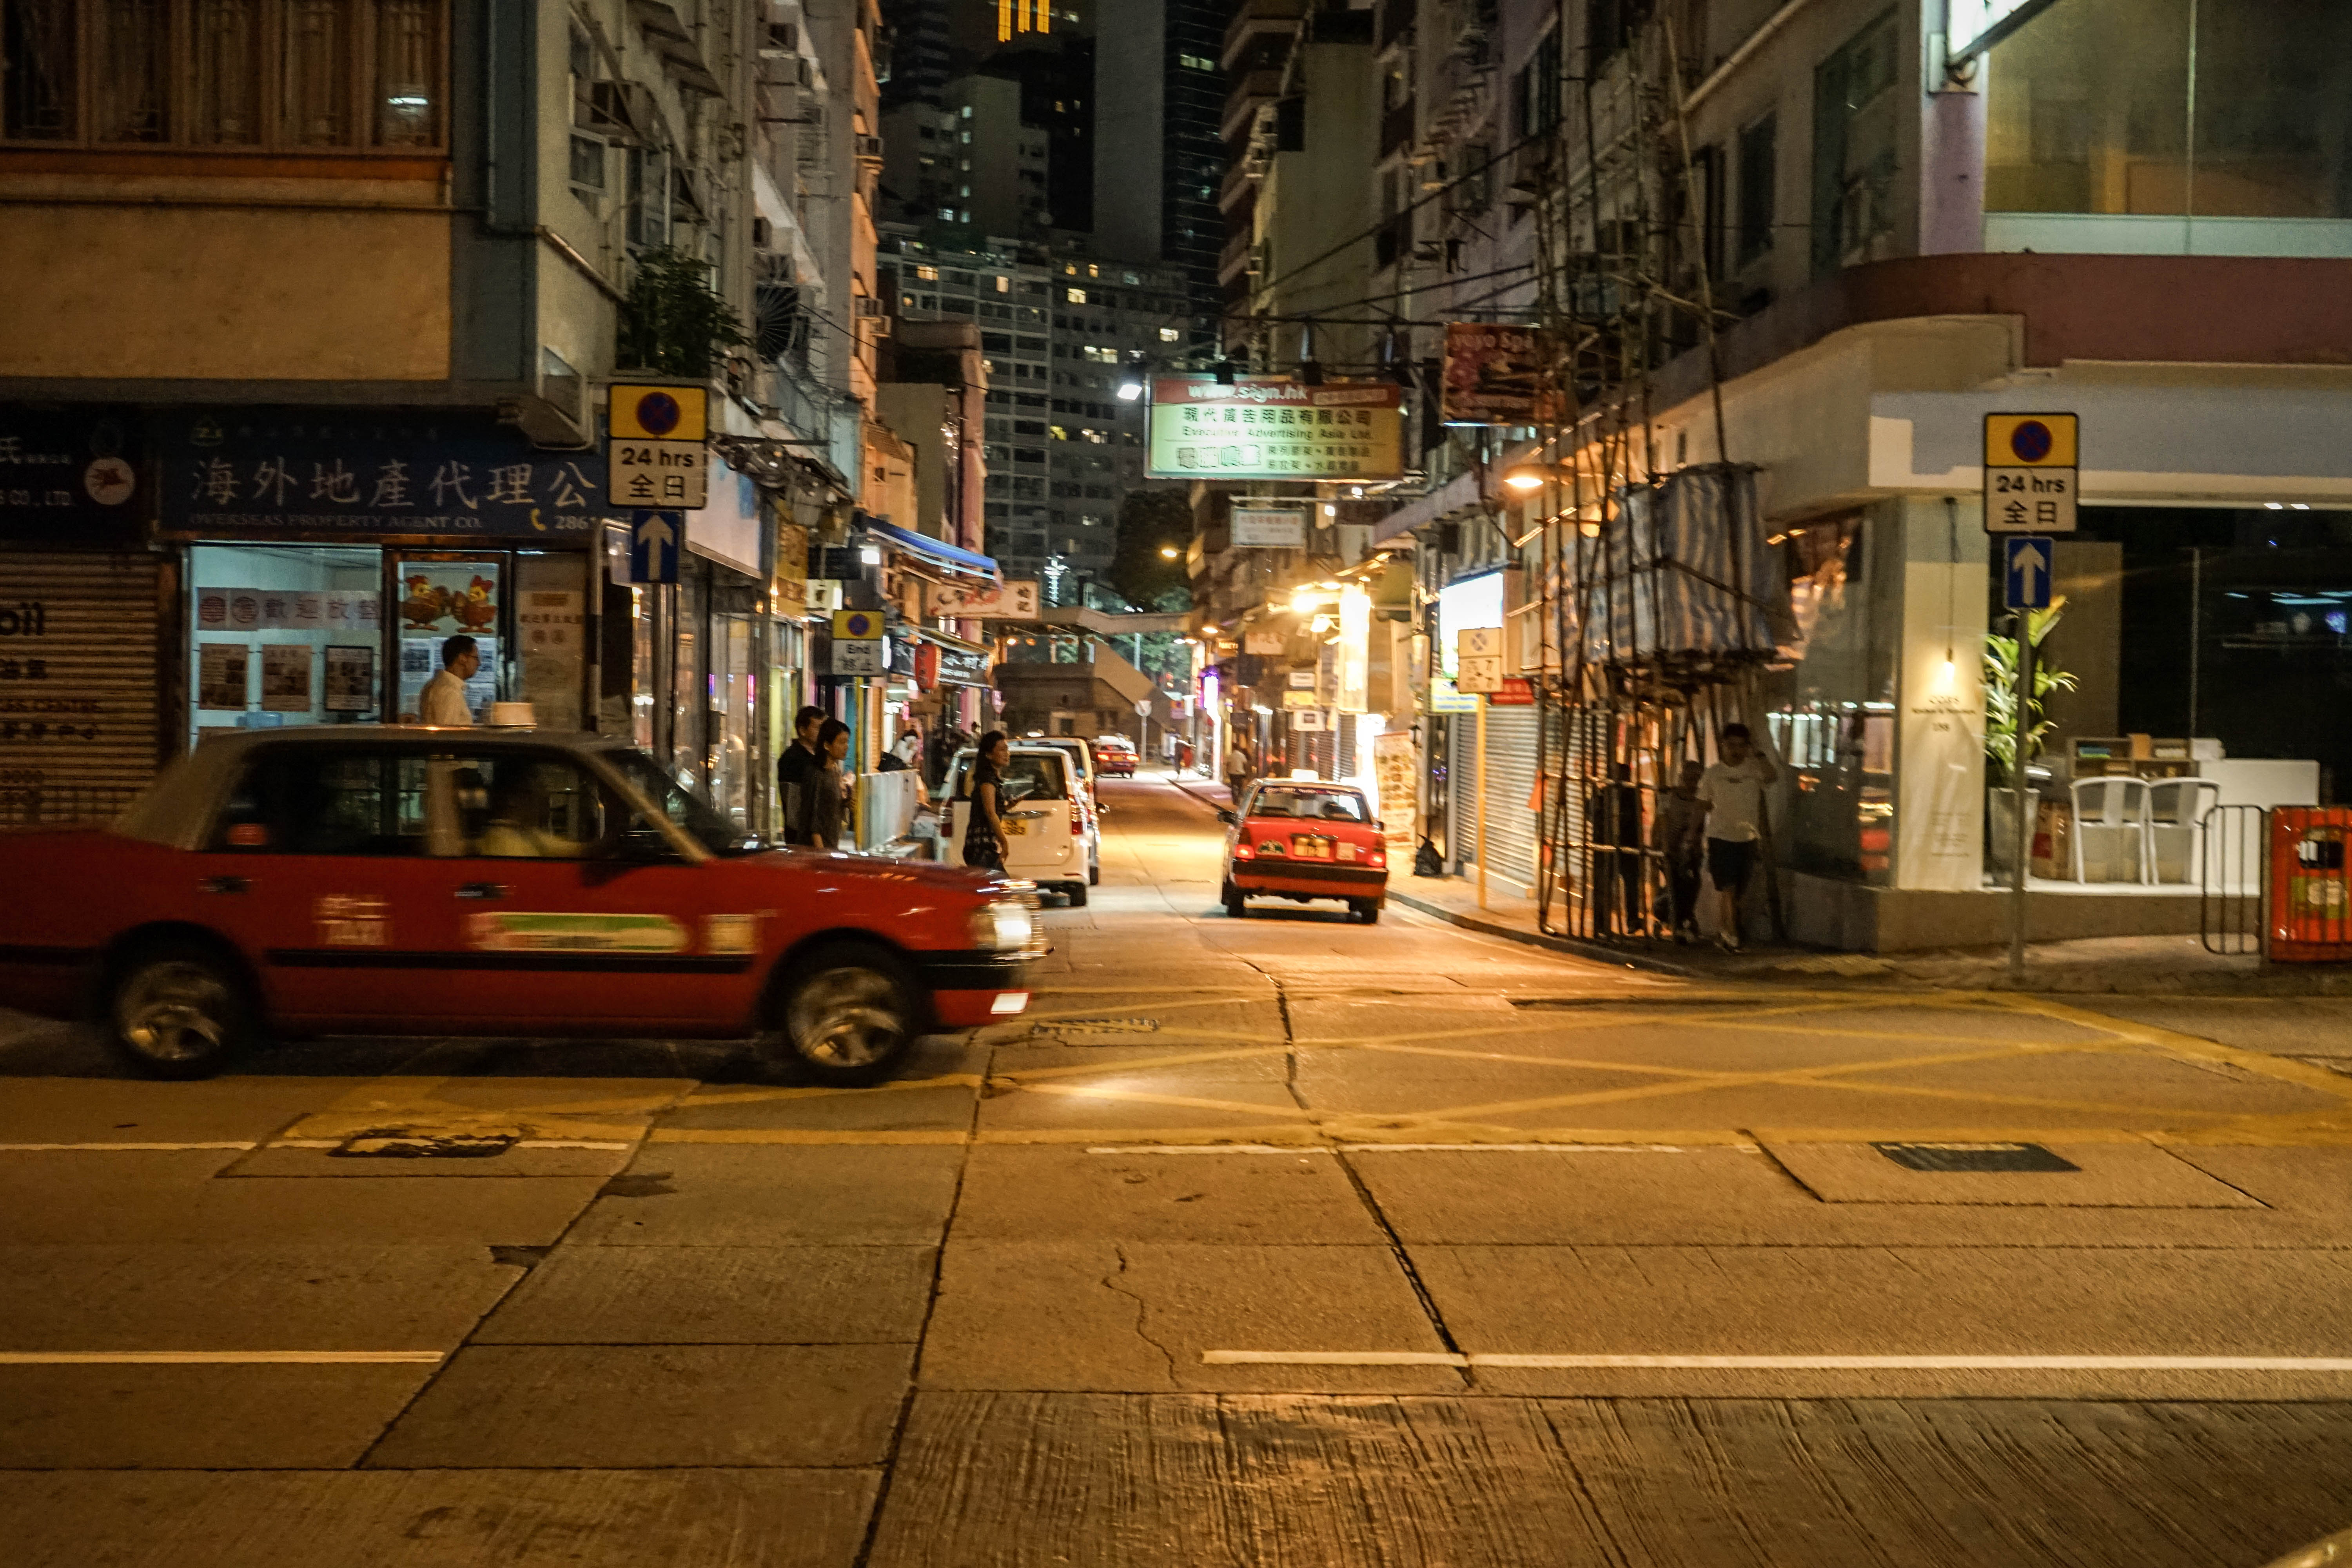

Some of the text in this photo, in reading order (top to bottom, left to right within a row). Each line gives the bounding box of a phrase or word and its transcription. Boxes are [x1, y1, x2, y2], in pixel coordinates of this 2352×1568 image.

[621, 447, 694, 467] 24 hrs
[191, 456, 597, 509] 海外地產代理公
[629, 474, 684, 499] 全日
[1996, 475, 2065, 493] 24 hrs
[2003, 501, 2056, 524] 全日
